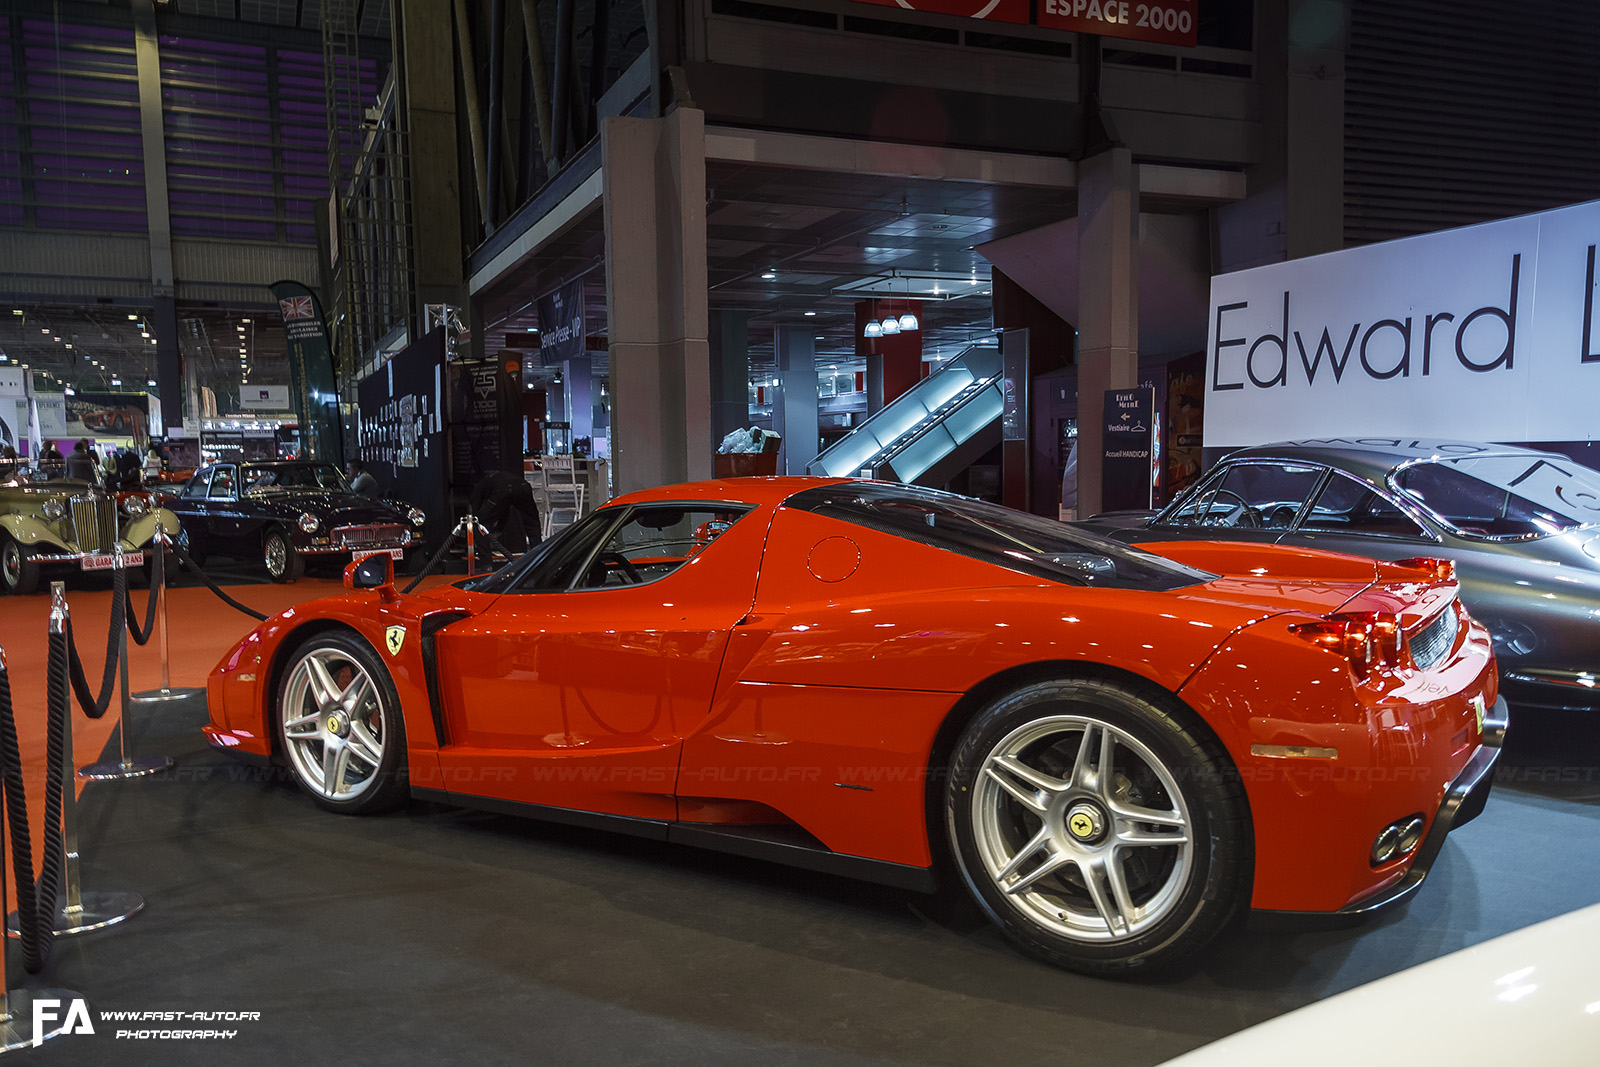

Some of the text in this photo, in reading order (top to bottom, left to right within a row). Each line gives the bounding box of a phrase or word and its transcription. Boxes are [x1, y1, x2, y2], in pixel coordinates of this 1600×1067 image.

[1045, 0, 1192, 34] ESPACE 2000
[1212, 253, 1522, 391] Edward
[1108, 424, 1130, 432] Vestiaire
[1105, 450, 1148, 458] Accueil HANDICAP
[131, 554, 143, 563] ANS
